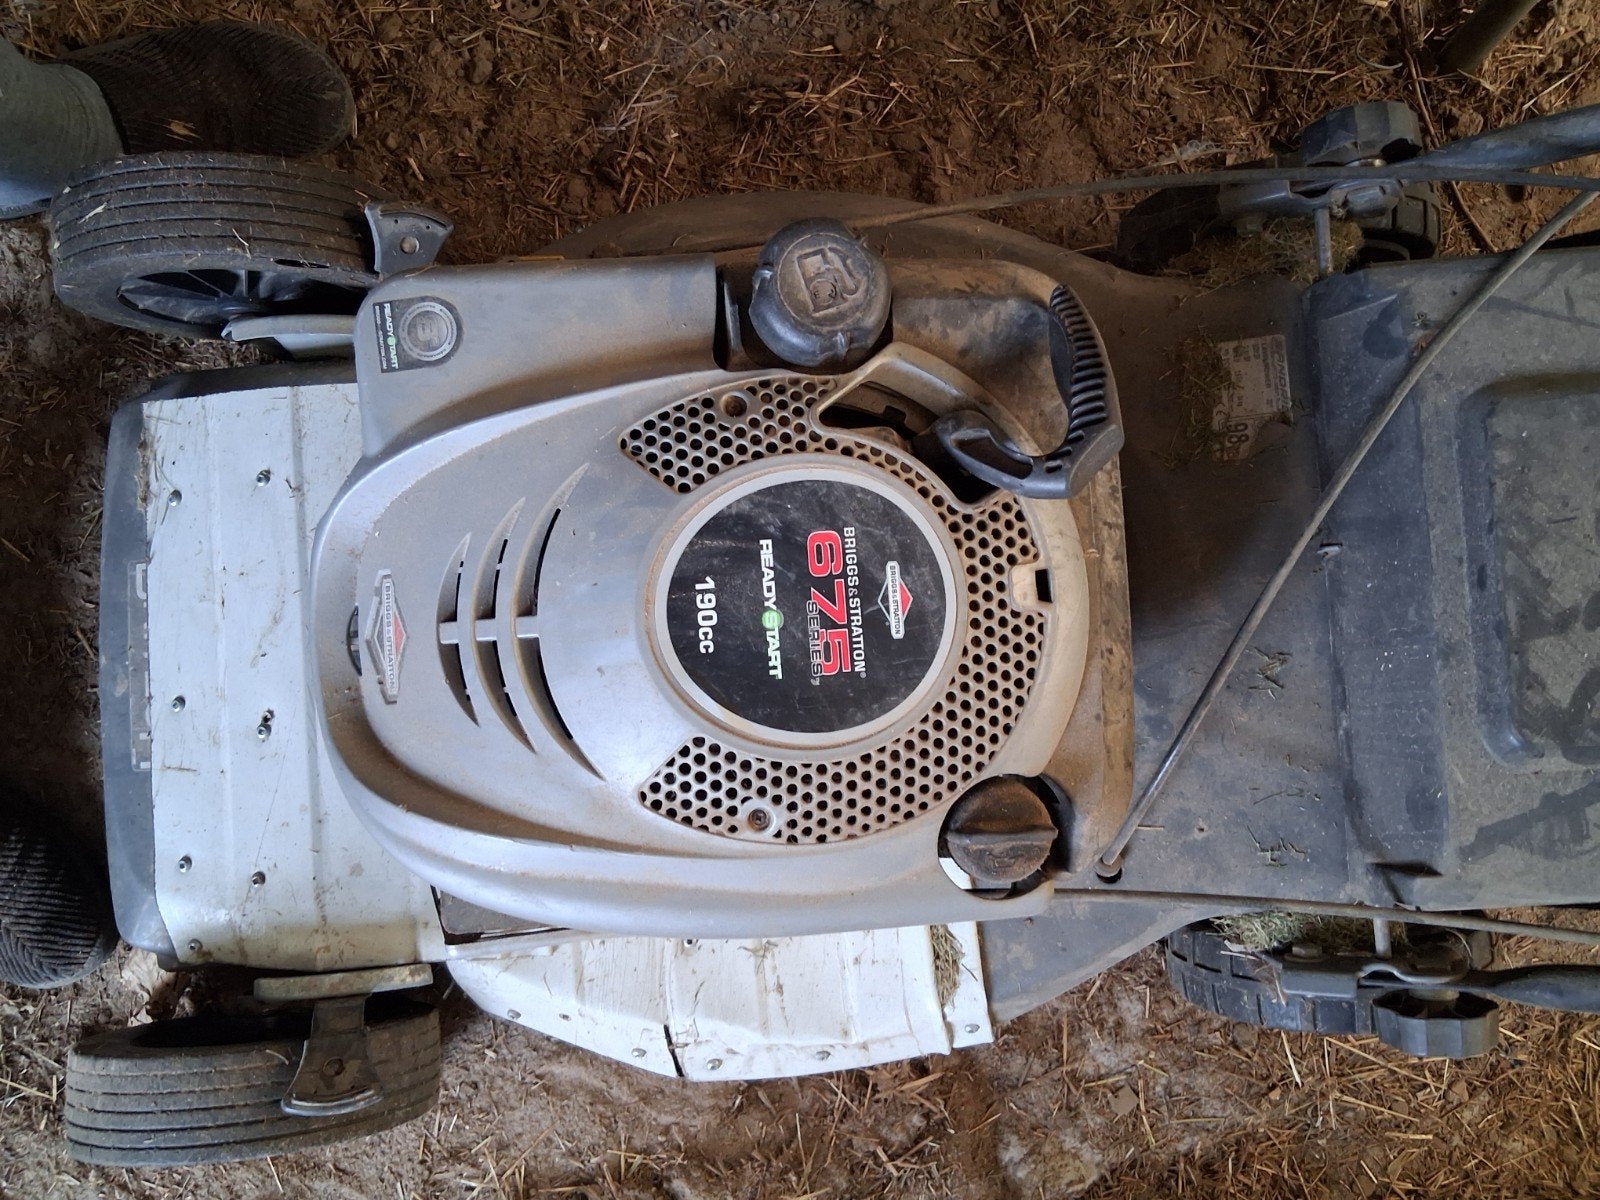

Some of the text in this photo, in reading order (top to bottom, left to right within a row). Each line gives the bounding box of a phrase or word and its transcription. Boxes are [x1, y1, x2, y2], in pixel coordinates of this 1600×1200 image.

[1226, 422, 1250, 445] 98
[694, 575, 718, 654] 190cc
[806, 600, 823, 677] SERIES
[807, 530, 851, 675] 675
